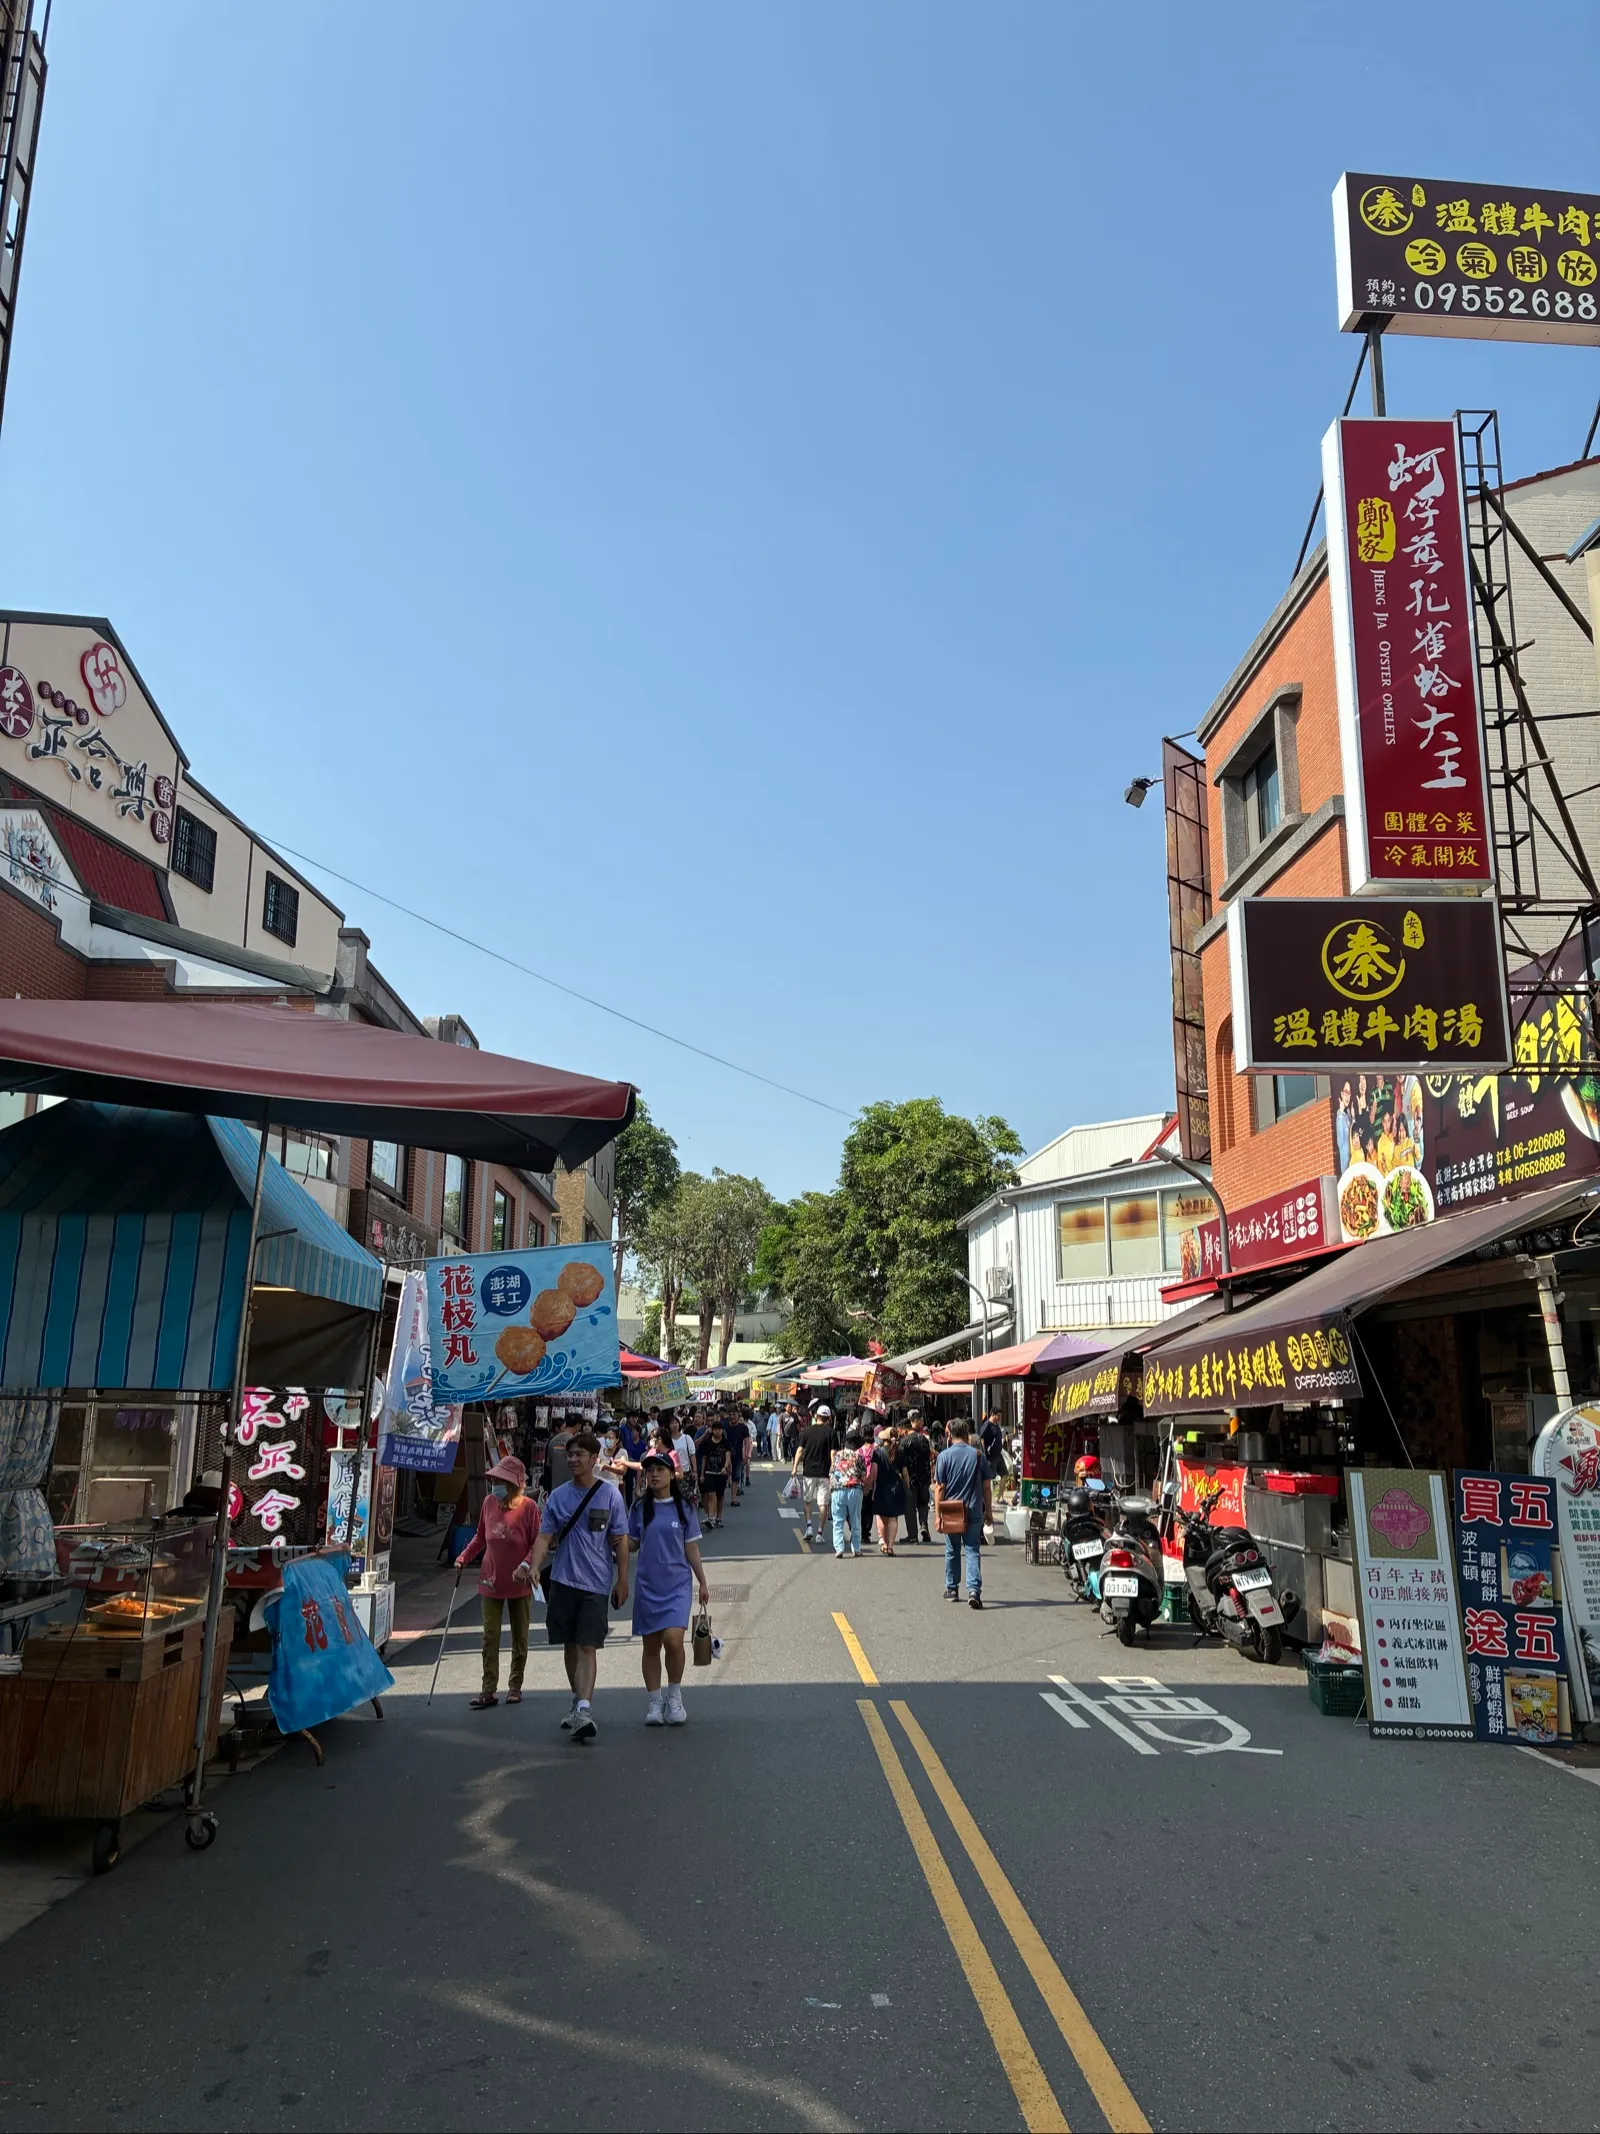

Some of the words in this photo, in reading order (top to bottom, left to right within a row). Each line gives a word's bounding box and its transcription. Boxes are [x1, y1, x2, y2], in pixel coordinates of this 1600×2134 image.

[1436, 198, 1600, 247] 溫體牛肉
[1408, 241, 1594, 285] 冷氣開放
[1366, 278, 1396, 292] 預約
[1361, 499, 1390, 560] 鄭家
[1371, 568, 1386, 606] JHENG
[1373, 611, 1388, 630] JIA
[1377, 640, 1392, 688] OYSTER
[1382, 693, 1396, 746] OMELETS
[1384, 811, 1477, 833] 團體合菜
[1384, 845, 1480, 868] 冷氣開放
[1405, 916, 1421, 944] 安平
[1272, 1003, 1484, 1052] 溫體牛肉湯
[1513, 1128, 1566, 1160] 06-2206088
[1514, 1152, 1566, 1182] 0955268882
[490, 1276, 521, 1291] 澎湖
[491, 1292, 521, 1307] 手工
[440, 1264, 478, 1368] 花枝丸
[1294, 1369, 1356, 1390] 0955268882
[700, 1391, 714, 1401] DIY
[1461, 1477, 1554, 1530] 買五
[1461, 1530, 1479, 1581] 波士頓
[1366, 1566, 1447, 1584] 百年古蹟
[1480, 1551, 1498, 1602] 龍蝦餅
[1391, 1637, 1448, 1650] 義式冰淇淋
[1465, 1607, 1560, 1662] 送五
[1393, 1656, 1439, 1670] 氣泡飲料
[1395, 1677, 1418, 1689] 咖啡
[1040, 1675, 1284, 1756] 慢
[1397, 1696, 1421, 1709] 甜點
[1485, 1665, 1504, 1735] 鮮爆蝦餅
